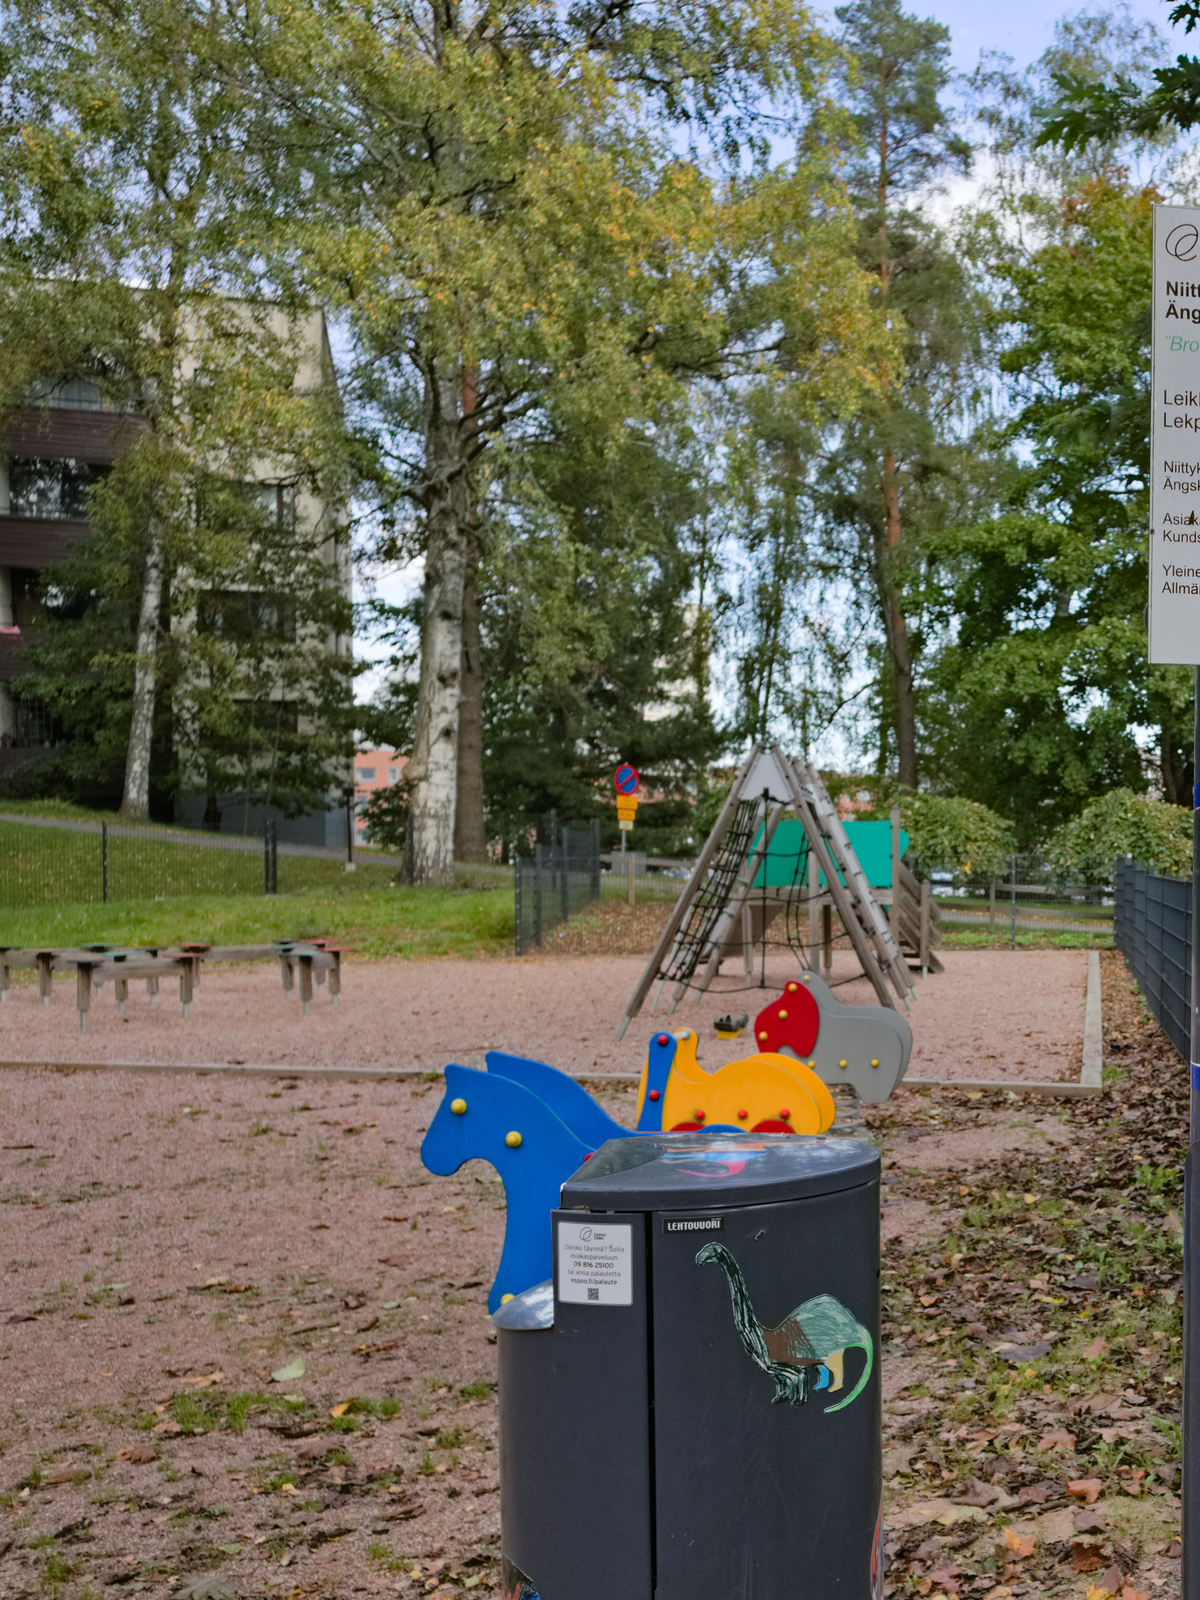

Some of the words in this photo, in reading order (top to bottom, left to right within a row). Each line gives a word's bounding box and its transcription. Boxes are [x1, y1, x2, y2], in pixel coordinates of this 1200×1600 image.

[564, 1243, 583, 1251] Olenko
[583, 1245, 607, 1253] täynnä?
[569, 1253, 618, 1261] asiakaspalveluun
[570, 1277, 618, 1286] espoo.fi/palaute
